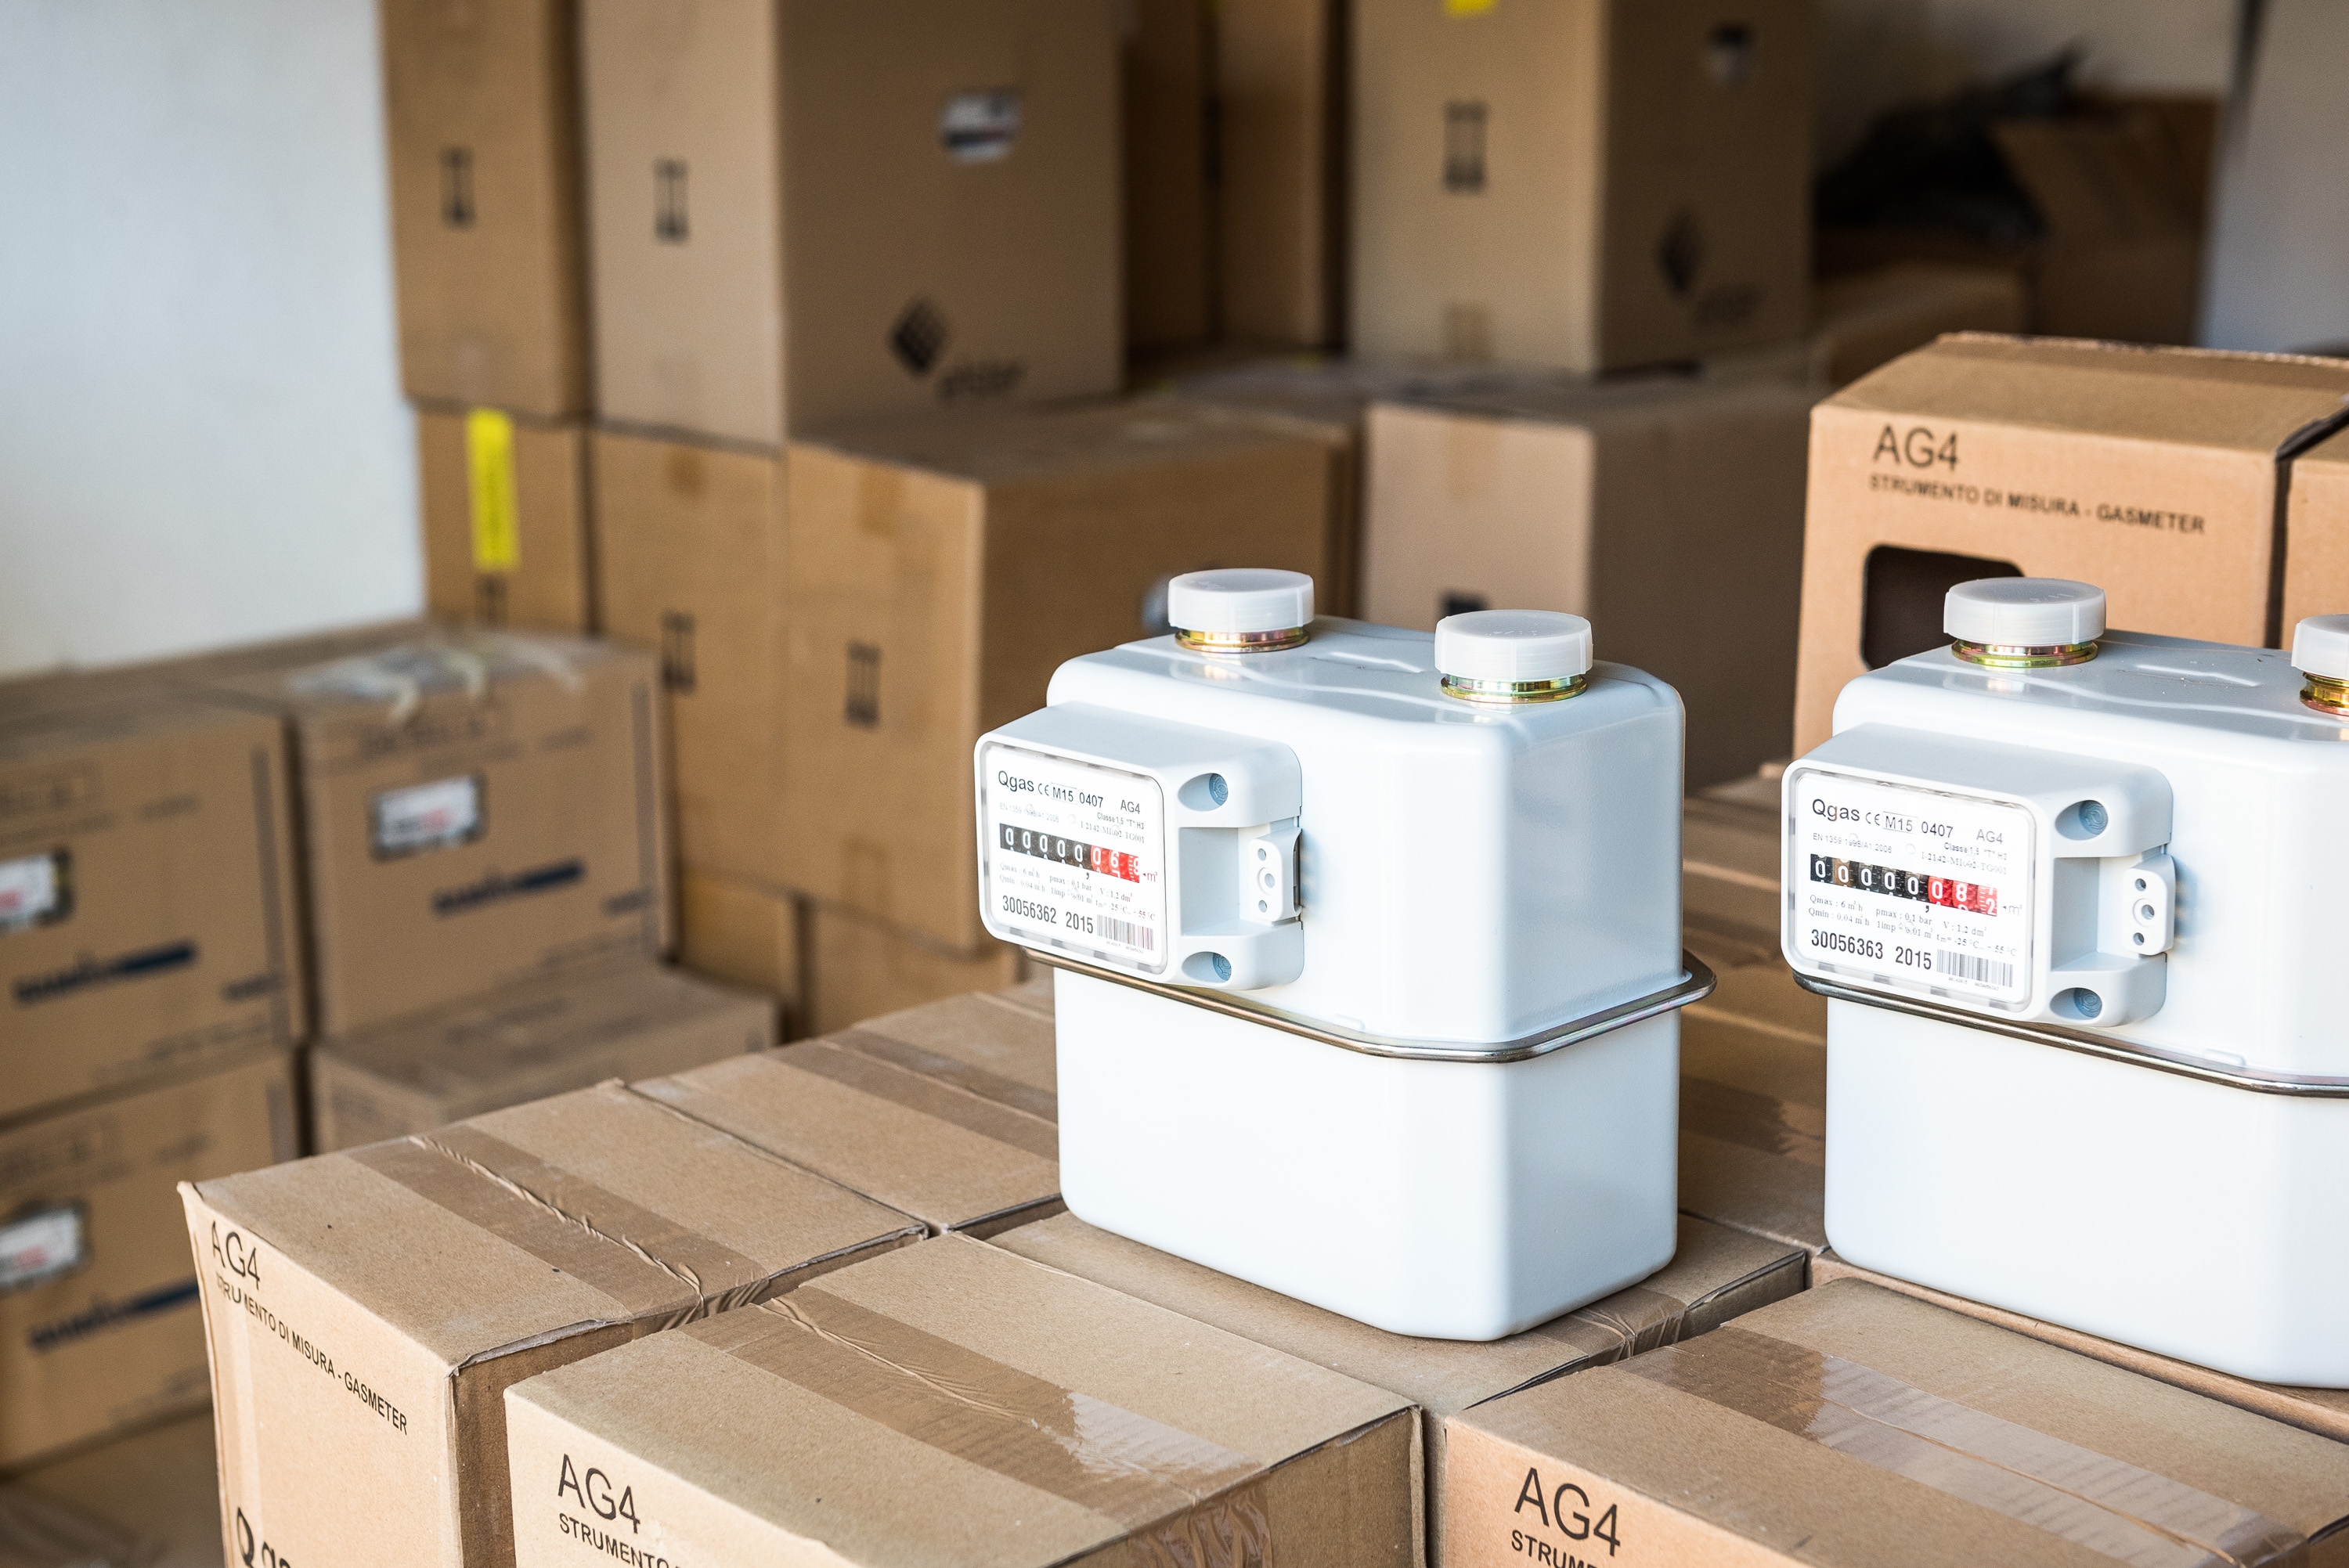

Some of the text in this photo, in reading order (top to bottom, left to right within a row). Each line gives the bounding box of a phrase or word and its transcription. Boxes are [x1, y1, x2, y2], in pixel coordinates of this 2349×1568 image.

[1872, 424, 1958, 472] AG4
[1869, 472, 1980, 505] STRUMENTO
[1983, 487, 2003, 507] DI
[2006, 492, 2080, 517] MISURA
[2096, 503, 2206, 534] GASMETER
[998, 770, 1034, 792] Qgas
[1052, 786, 1073, 802] M15
[1079, 791, 1103, 808] 0407
[1120, 799, 1140, 814] AG4
[1097, 812, 1115, 823] Classe
[1812, 798, 1860, 822] Qgas
[1885, 815, 1913, 832] M15
[1921, 821, 1954, 838] 0407
[1976, 828, 2004, 845] AG4
[1813, 832, 1823, 842] EN
[1943, 842, 1968, 853] Classe
[999, 861, 1017, 872] Qmax
[1049, 875, 1066, 885] pmax
[1082, 882, 1092, 892] bar
[999, 874, 1016, 884] Qmin
[1002, 895, 1094, 934] 30056362 2015
[1808, 907, 1829, 917] Qmin
[1810, 894, 1833, 906] Qmax
[1876, 908, 1897, 918] pmax
[1918, 915, 1932, 925] bar
[1943, 921, 1950, 929] V
[1811, 929, 1932, 970] 30056363 2015
[211, 1220, 260, 1291] AG4
[279, 1320, 289, 1344] DI
[292, 1331, 335, 1379] MISURA
[345, 1372, 407, 1436] GASMETER
[558, 1453, 640, 1534] AG4
[1514, 1467, 1621, 1557] AG4
[1511, 1530, 1599, 1568] STRUM
